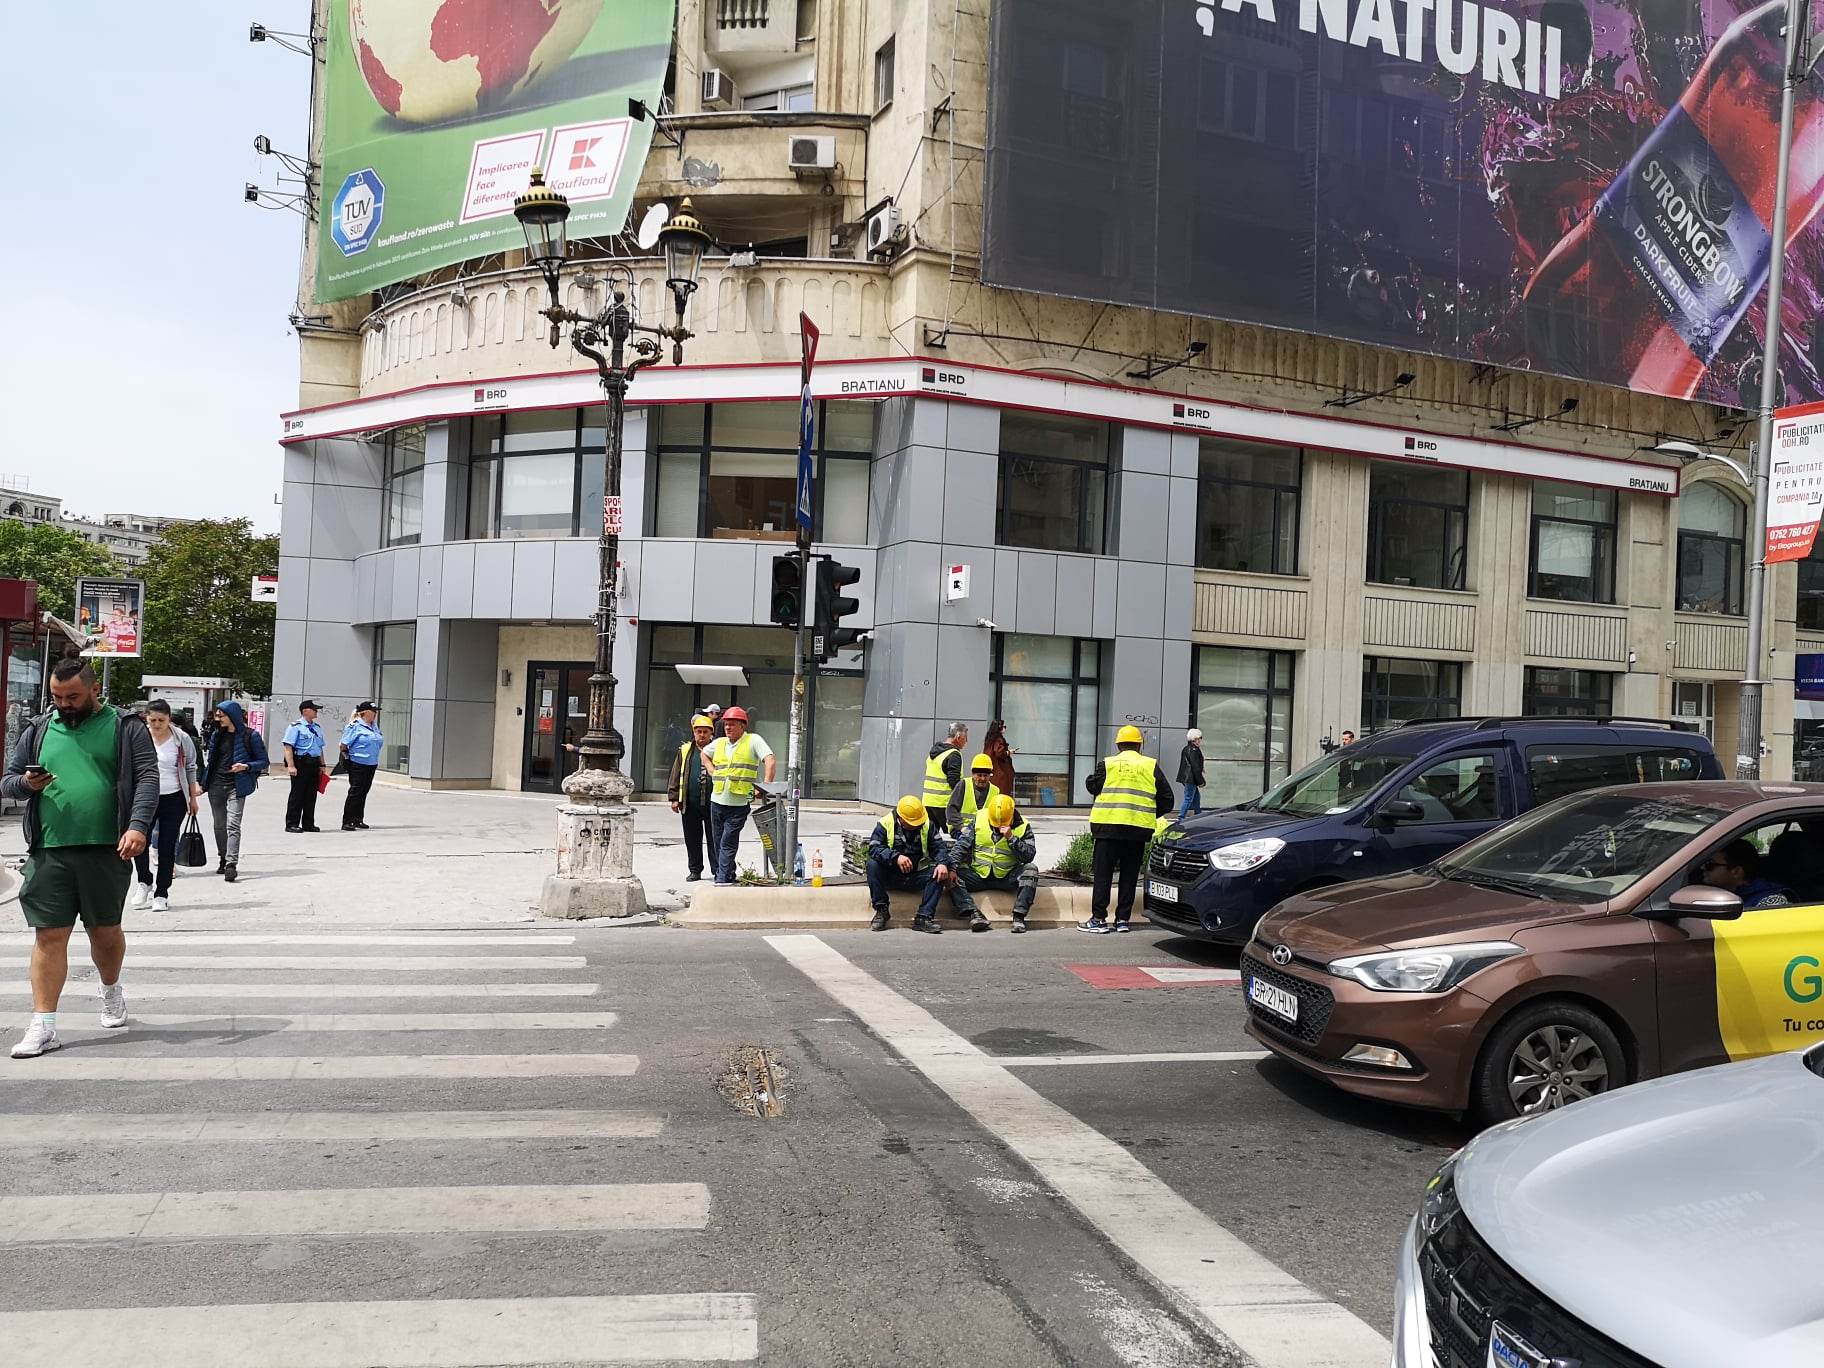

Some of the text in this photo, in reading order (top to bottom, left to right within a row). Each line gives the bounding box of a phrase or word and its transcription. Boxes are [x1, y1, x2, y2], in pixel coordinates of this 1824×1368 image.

[1299, 0, 1562, 101] NATURII
[478, 160, 530, 177] Implicarea
[476, 180, 496, 192] face
[550, 173, 608, 191] Kaufland
[344, 197, 371, 221] TÜV
[1655, 214, 1708, 286] APPLE CIDERS
[1634, 223, 1700, 311] DARK FRUIT
[1656, 287, 1676, 315] NEGRE
[841, 378, 906, 393] BRATIANU
[939, 372, 965, 385] BRD
[486, 389, 507, 400] BRD
[1187, 407, 1210, 419] BRD
[291, 420, 304, 430] BRD
[1782, 423, 1824, 439] PUBLICITAT
[1417, 440, 1437, 451] BRD
[1629, 477, 1669, 492] BRATIANU
[1776, 492, 1810, 504] COMPANIA
[1254, 980, 1266, 1002] GR
[1267, 986, 1277, 1007] 21
[1783, 1018, 1802, 1032] Tu
